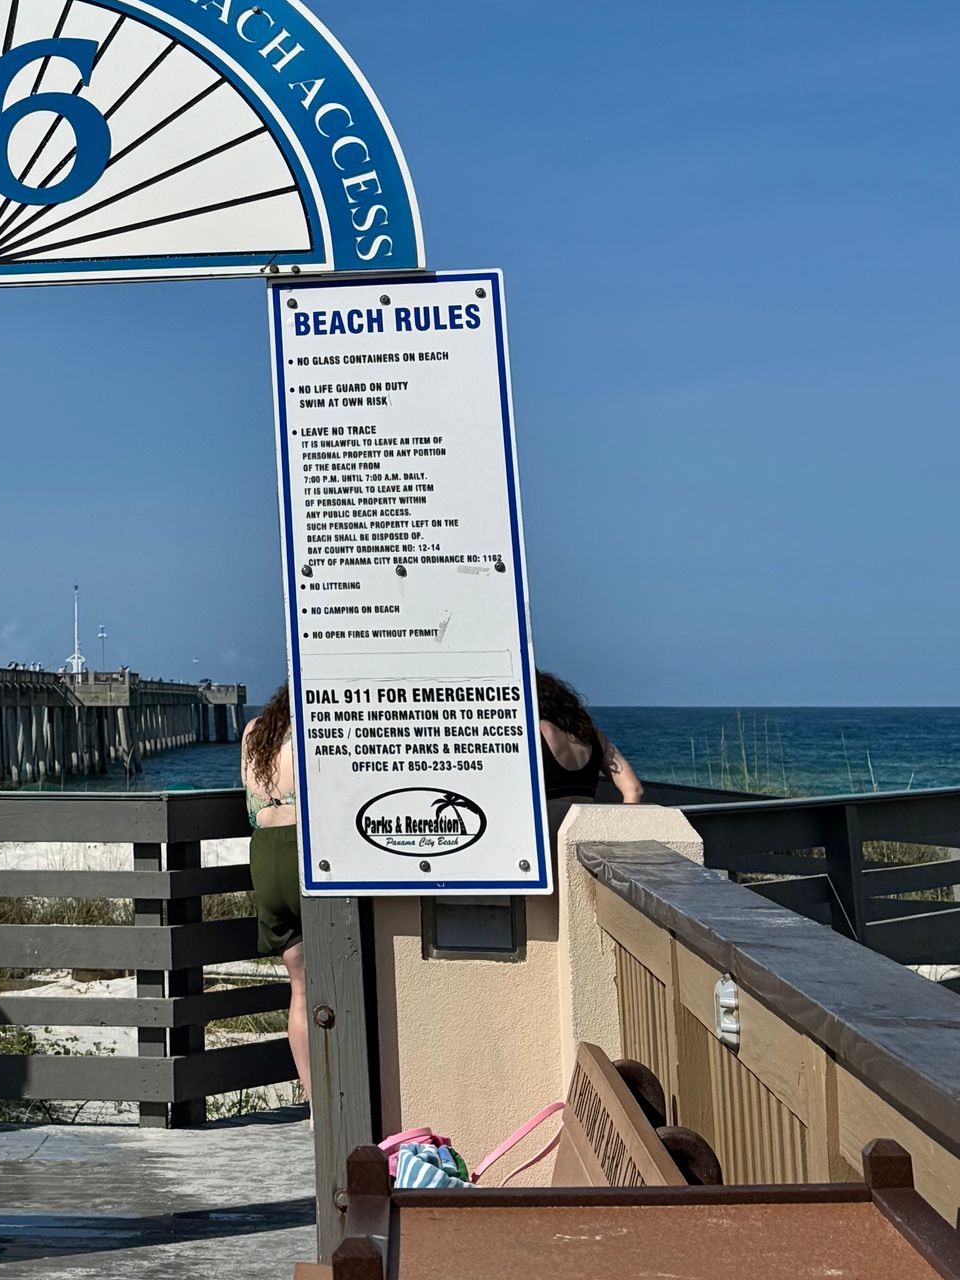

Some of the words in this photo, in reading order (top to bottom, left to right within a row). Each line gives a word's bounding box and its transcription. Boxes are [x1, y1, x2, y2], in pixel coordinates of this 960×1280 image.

[288, 76, 393, 263] ACCESS
[294, 308, 384, 336] BEACH
[395, 303, 481, 332] RULES
[297, 356, 310, 366] NO
[312, 355, 340, 366] GLASS
[343, 353, 400, 365] CONTAINERS
[403, 352, 416, 362] ON
[418, 351, 449, 362] BEACH
[299, 385, 311, 394] NO
[314, 384, 333, 394] LIFE
[336, 383, 367, 393] GUARD
[369, 382, 382, 392] ON
[385, 381, 408, 391] DUTY
[299, 398, 325, 409] SWIM
[328, 398, 340, 407] AT
[342, 397, 364, 407] OWN
[366, 396, 387, 406] RISK
[301, 426, 329, 437] LEAVE
[332, 426, 344, 436] NO
[347, 425, 377, 436] TRACE
[304, 475, 321, 484] 7:00
[323, 474, 340, 483] P.M.
[342, 474, 363, 483] UNTIL
[365, 473, 382, 482] 7:00
[384, 473, 402, 481] A.M.
[404, 472, 428, 481] DAILY.
[309, 582, 320, 591] NO
[322, 582, 361, 591] LITTERING
[312, 630, 324, 640] NO
[325, 630, 346, 639] OPEN
[347, 629, 370, 638] FIRES
[372, 629, 408, 638] WITHOUT
[409, 628, 438, 637] PERMIT
[306, 689, 339, 704] DIAL
[344, 688, 371, 703] 911
[377, 688, 407, 702] FOR
[412, 686, 520, 702] EMERGENCIES
[310, 711, 331, 722] FOR
[334, 711, 364, 722] MORE
[367, 710, 439, 721] INFORMATION
[443, 710, 457, 720] OR
[460, 709, 473, 720] TO
[477, 708, 517, 719] REPORT
[352, 761, 388, 772] OFFICE
[391, 761, 405, 772] AT
[408, 760, 483, 771] 850-233-5045
[364, 816, 392, 834] Parks
[395, 817, 402, 833] &
[405, 816, 459, 834] Recreation
[386, 837, 416, 846] Panama
[418, 837, 434, 847] City
[438, 837, 458, 846] Beach
